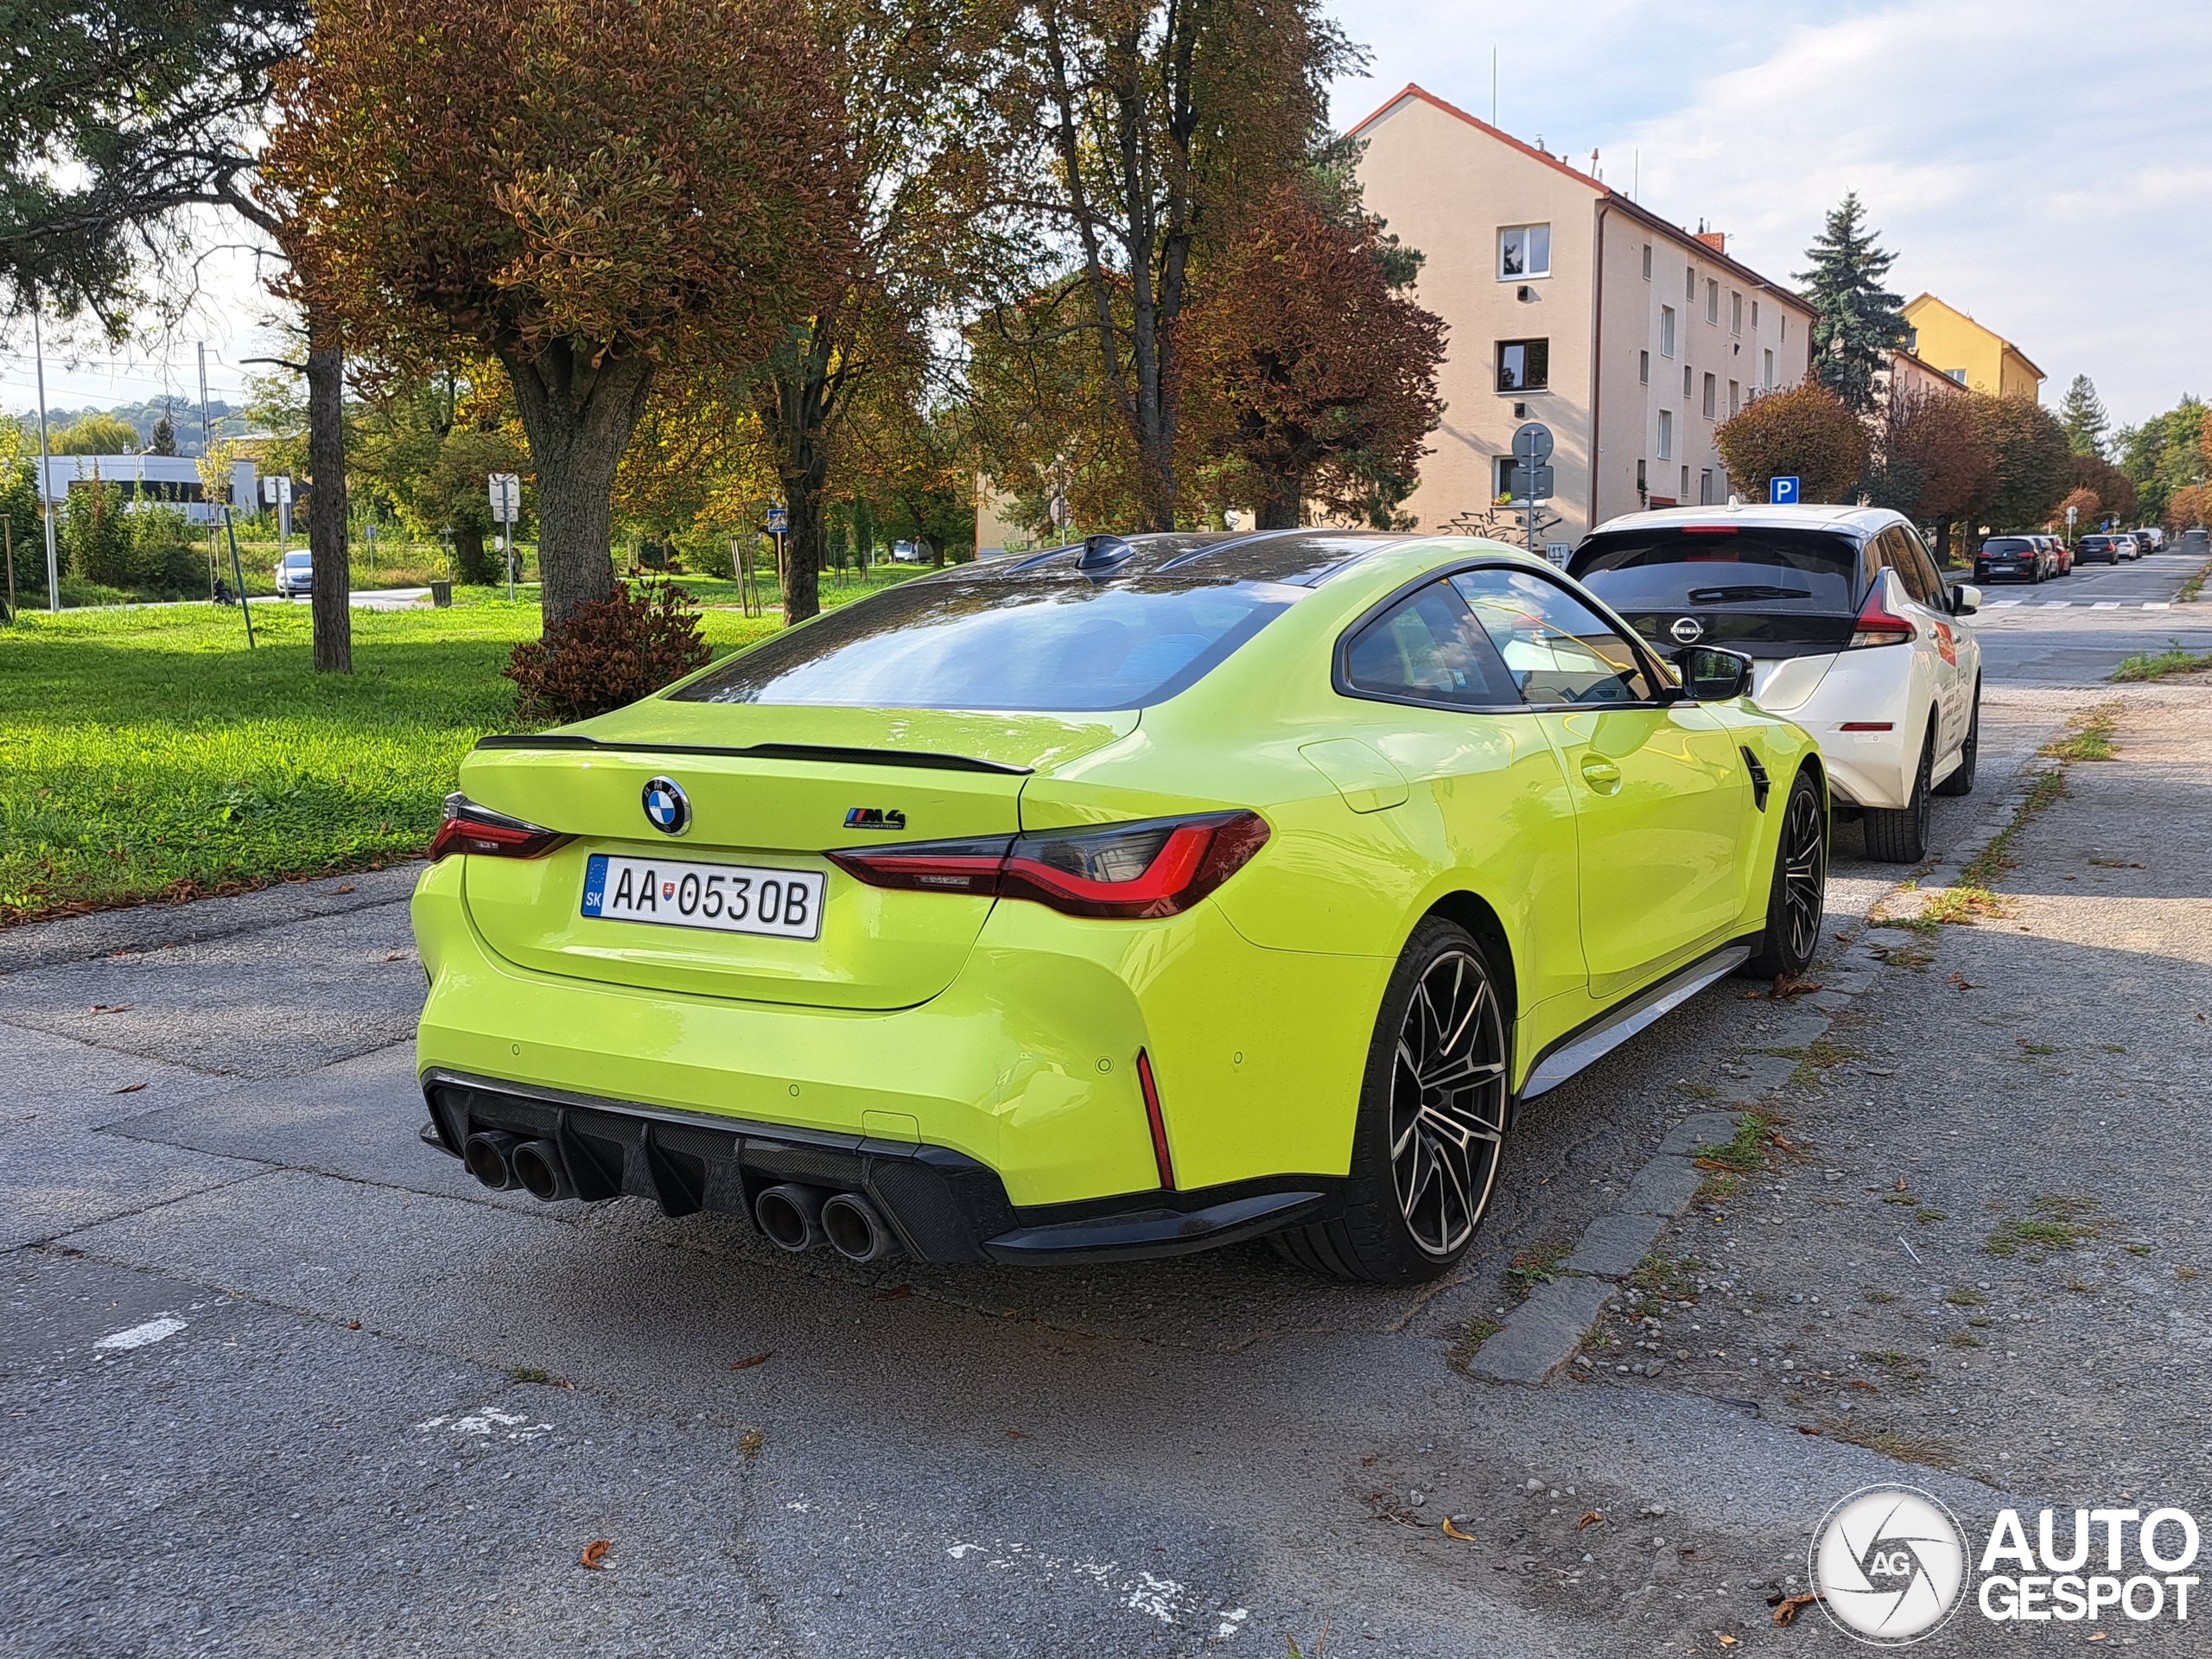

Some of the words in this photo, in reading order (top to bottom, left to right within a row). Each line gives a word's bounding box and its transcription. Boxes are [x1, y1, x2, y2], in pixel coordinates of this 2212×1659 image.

[1777, 480, 1792, 502] P
[644, 779, 678, 800] BMW
[586, 892, 602, 907] SK
